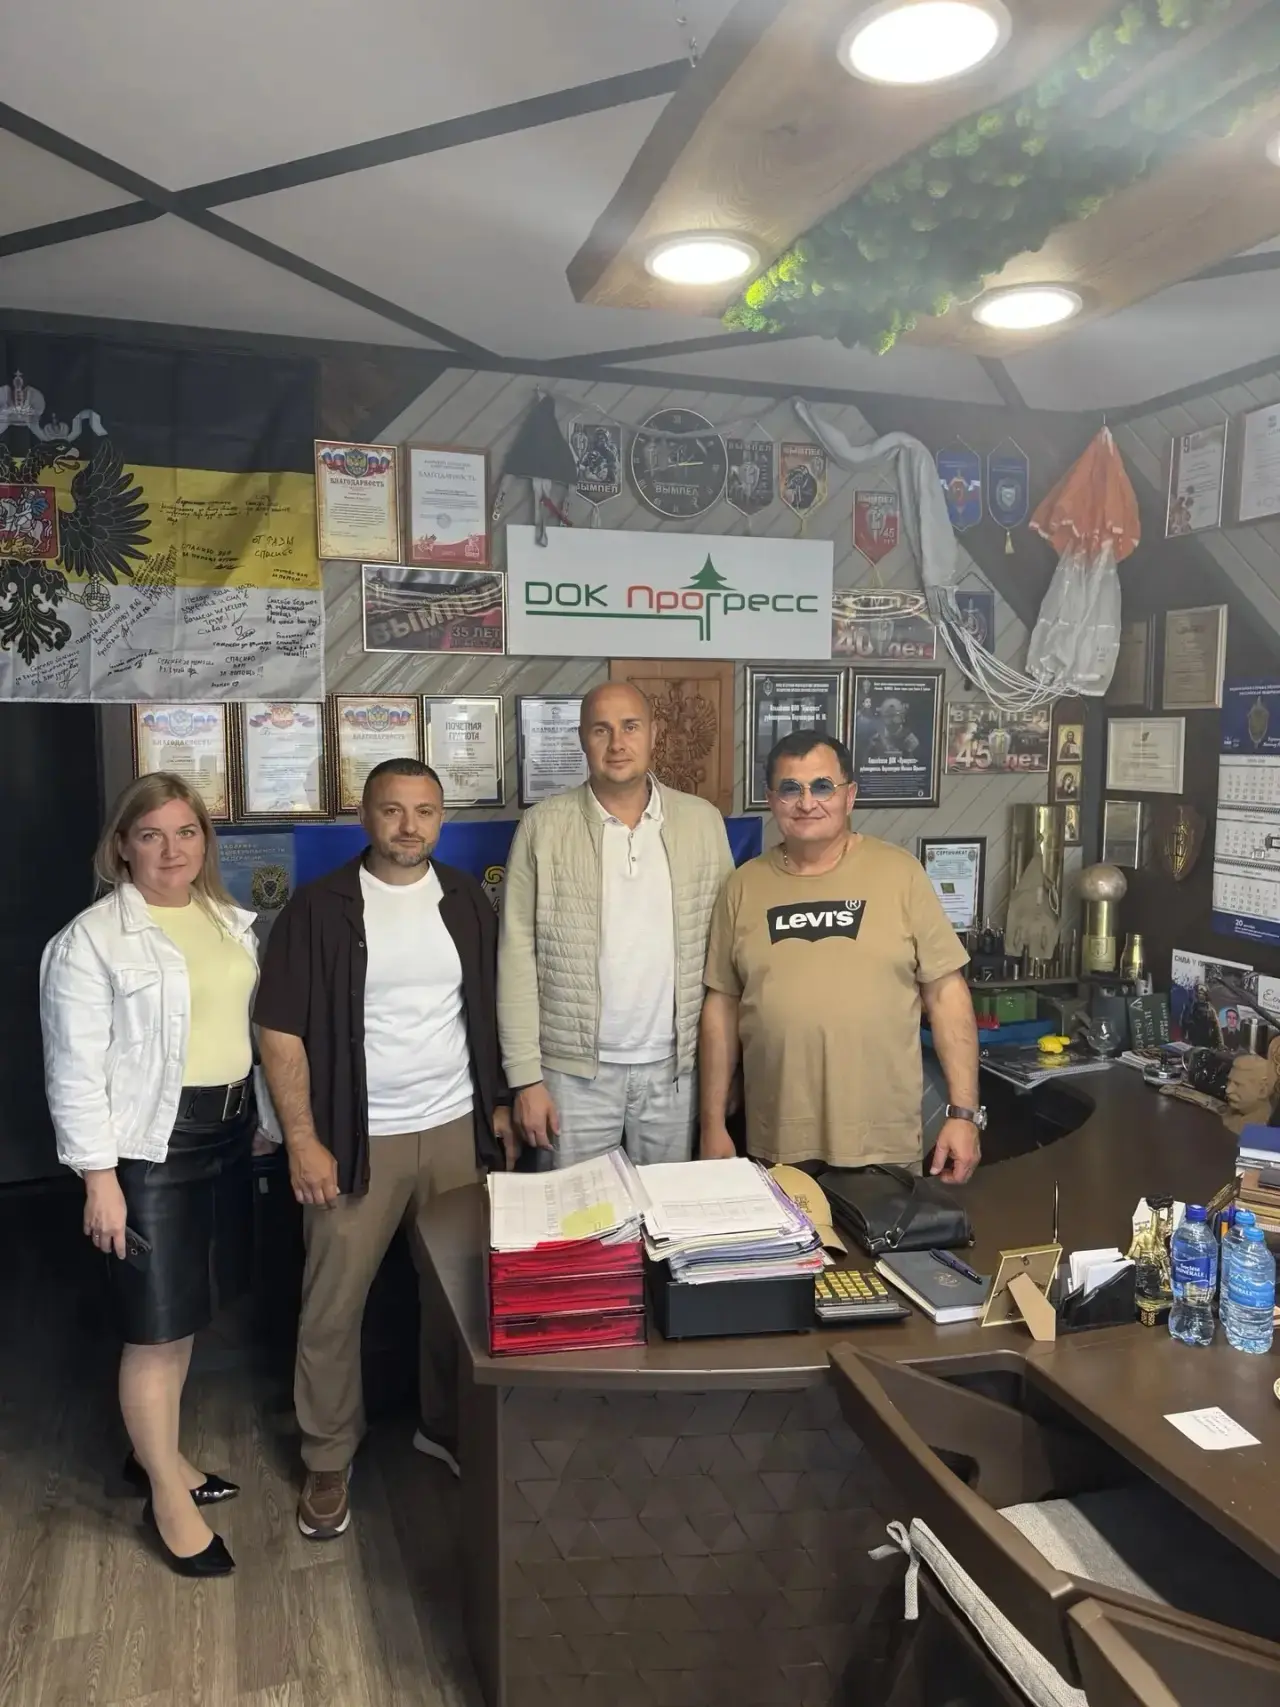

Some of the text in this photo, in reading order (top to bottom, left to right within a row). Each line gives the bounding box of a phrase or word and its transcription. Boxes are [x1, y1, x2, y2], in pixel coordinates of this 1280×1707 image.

[330, 477, 385, 488] БЛАГОДАРНОСТЬ
[655, 484, 699, 496] ВЫМПЕЛ
[883, 528, 895, 538] 45
[452, 626, 501, 638] 35 ЛЕТ
[835, 628, 873, 655] 40
[951, 709, 1049, 722] ВЫМПЕЛ
[955, 739, 1045, 769] 45 лет
